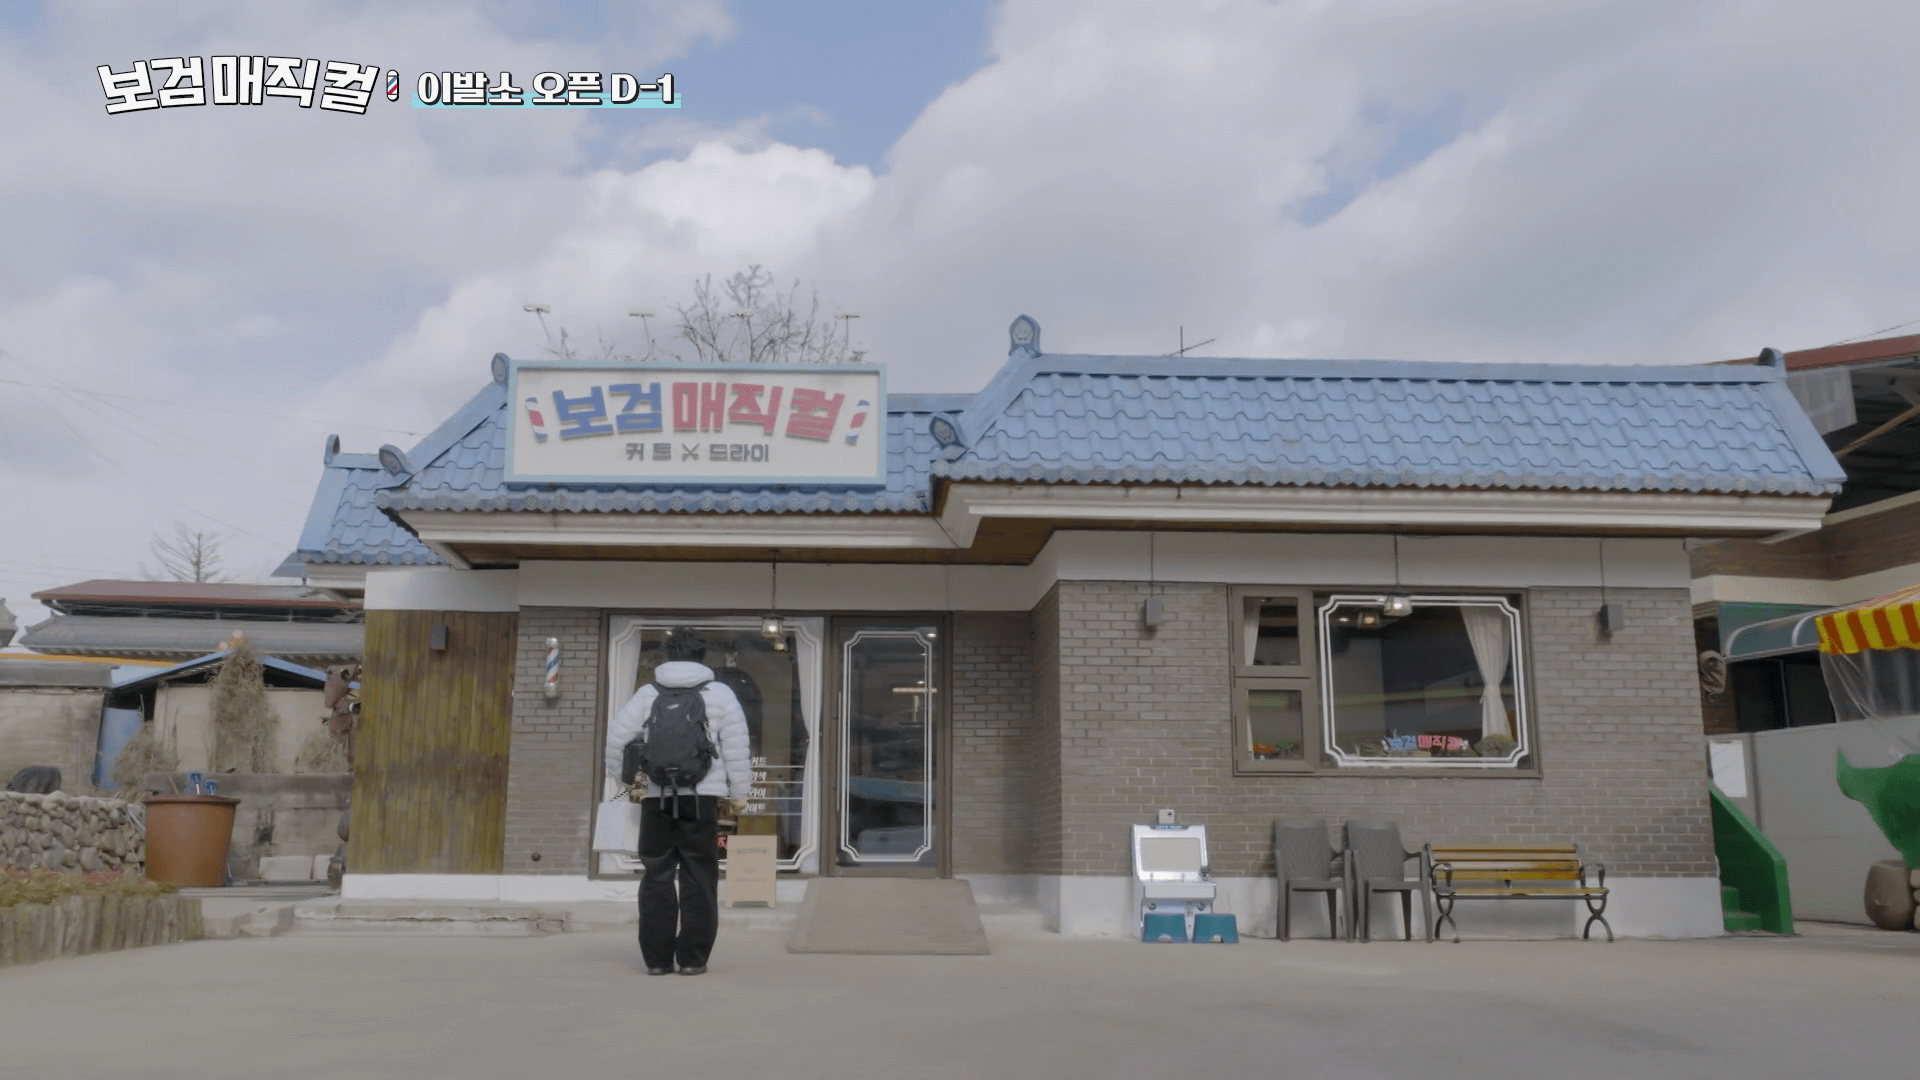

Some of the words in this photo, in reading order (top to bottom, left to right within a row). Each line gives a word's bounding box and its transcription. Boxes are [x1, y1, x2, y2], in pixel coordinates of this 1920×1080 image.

[552, 381, 663, 440] 보검
[672, 381, 845, 442] 매직컬
[709, 443, 769, 463] 드라이
